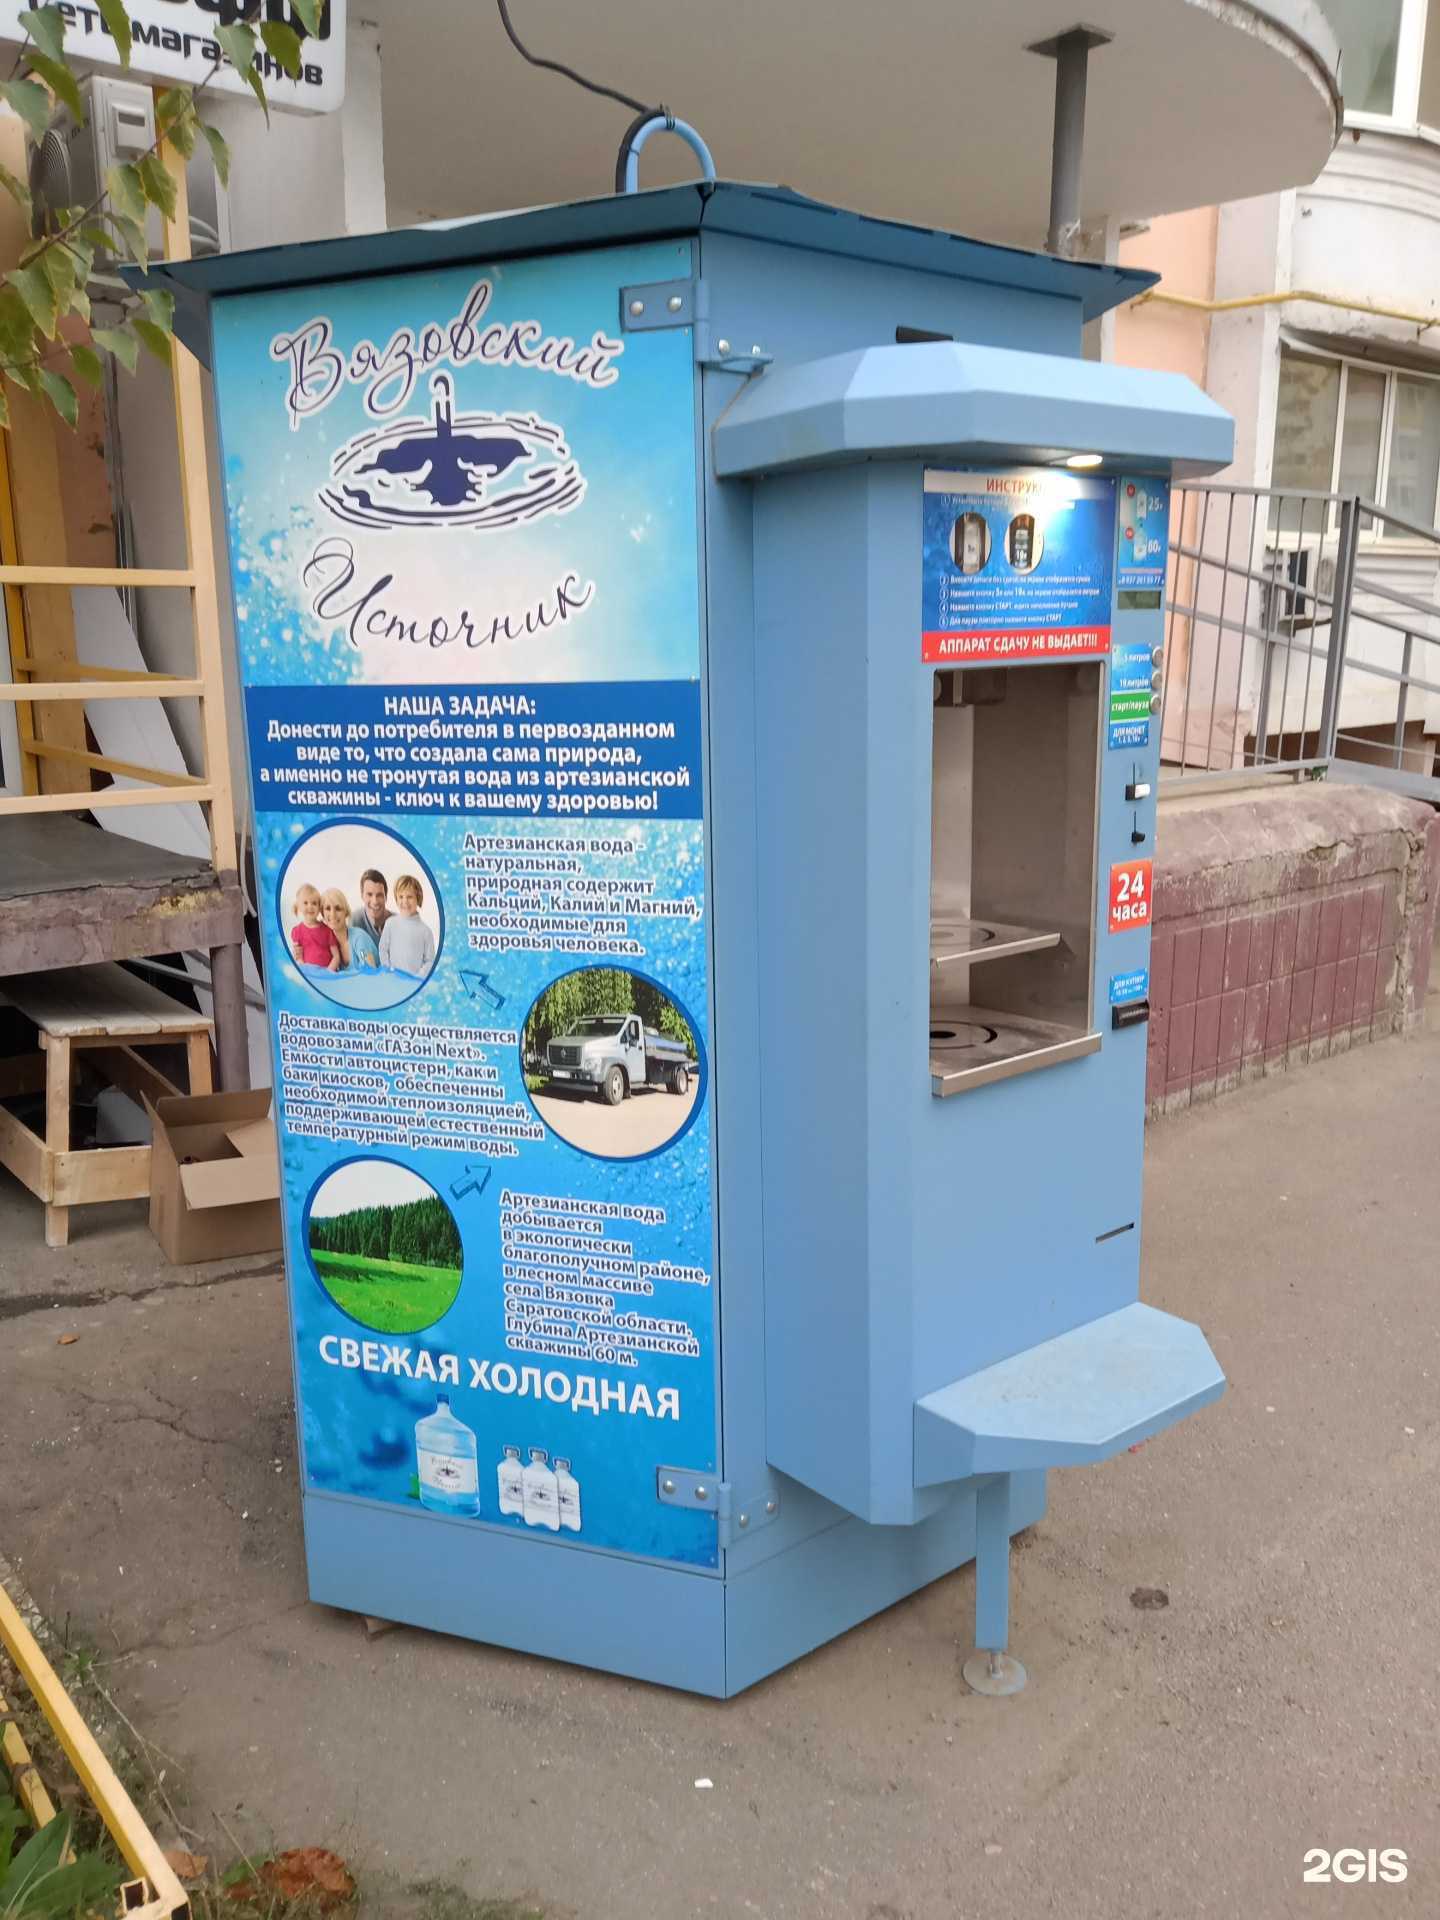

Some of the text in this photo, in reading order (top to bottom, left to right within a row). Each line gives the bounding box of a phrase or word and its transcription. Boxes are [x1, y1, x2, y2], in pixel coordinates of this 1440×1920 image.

[273, 283, 618, 430] Вязовский
[303, 537, 593, 648] Источник
[939, 638, 991, 654] АППАРАТ
[994, 635, 1029, 653] СДАЧУ
[1032, 635, 1045, 650] НЕ
[384, 695, 537, 719] НАША ЗАДАЧА:
[267, 719, 676, 744] Донести до потребителя в первозданном
[296, 745, 643, 768] виде то, что создала сама природа,
[260, 766, 690, 792] а именно не тронутая вода из артезианской
[288, 788, 381, 807] скважины
[396, 791, 445, 809] ключ
[449, 792, 461, 808] к
[465, 792, 542, 813] вашему
[547, 790, 659, 814] здоровью!
[465, 834, 585, 852] Артезианская
[590, 841, 633, 855] вода
[465, 857, 582, 873] натуральная,
[466, 876, 654, 895] природная содержит
[1117, 870, 1144, 902] 24
[468, 894, 701, 917] Кальций, Калий и Магний,
[1112, 900, 1147, 922] часа
[469, 914, 626, 936] необходимые для
[469, 935, 644, 954] здоровья человека.
[280, 1013, 516, 1044] Доставка воды осуществляется
[281, 1034, 485, 1061] водовозами «ГАЗон Next».
[282, 1050, 496, 1079] Емкости автоцистерн, как и
[283, 1066, 504, 1098] баки киосков, обеспеченны
[285, 1085, 531, 1120] необходимой теплоизоляцией,
[286, 1103, 544, 1138] поддерживающей естественный
[288, 1121, 518, 1155] температурный режим воды.
[502, 1191, 665, 1224] Артезианская вода
[502, 1212, 602, 1233] добывается
[503, 1230, 631, 1254] в экологически
[504, 1245, 710, 1284] благополучном районе,
[505, 1265, 653, 1294] в лесном массиве
[505, 1284, 614, 1308] села Вязовка
[506, 1299, 692, 1336] Саратовской области.
[507, 1316, 699, 1355] Глубина Артезианской
[508, 1336, 637, 1366] скважины 60 м.
[319, 1335, 681, 1421] СВЕЖАЯ ХОЛОДНАЯ
